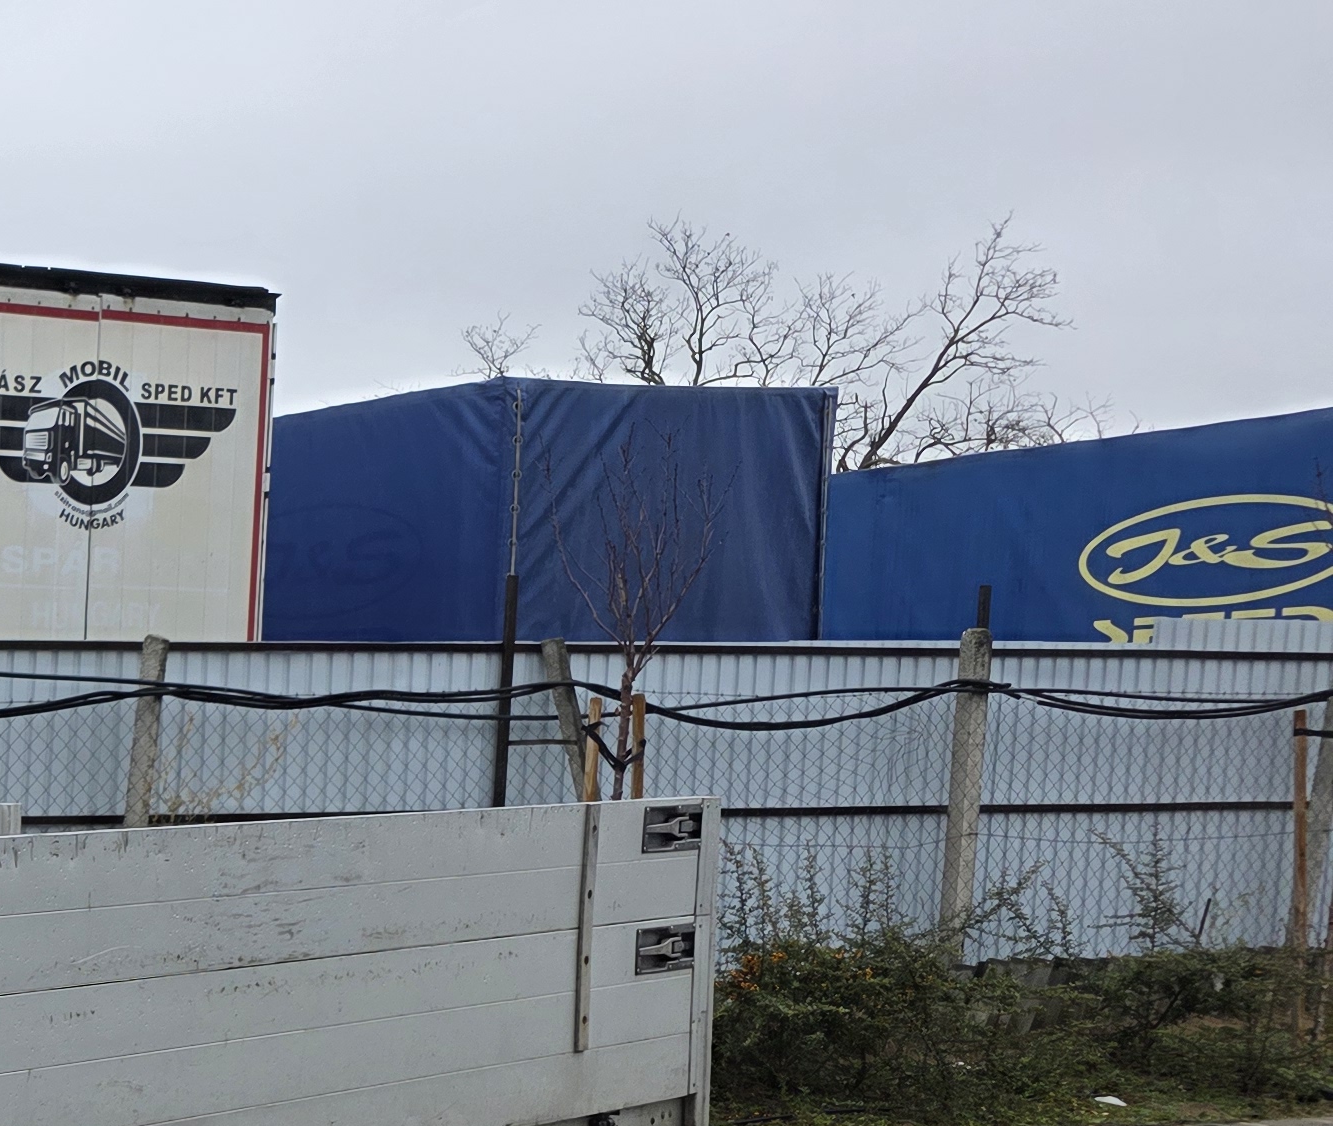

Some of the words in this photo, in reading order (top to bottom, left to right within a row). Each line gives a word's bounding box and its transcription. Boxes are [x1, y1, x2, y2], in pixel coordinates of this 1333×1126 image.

[58, 360, 130, 392] MOBIL
[140, 382, 192, 403] SPED
[199, 387, 238, 406] KFT
[59, 508, 125, 531] HUNGARY
